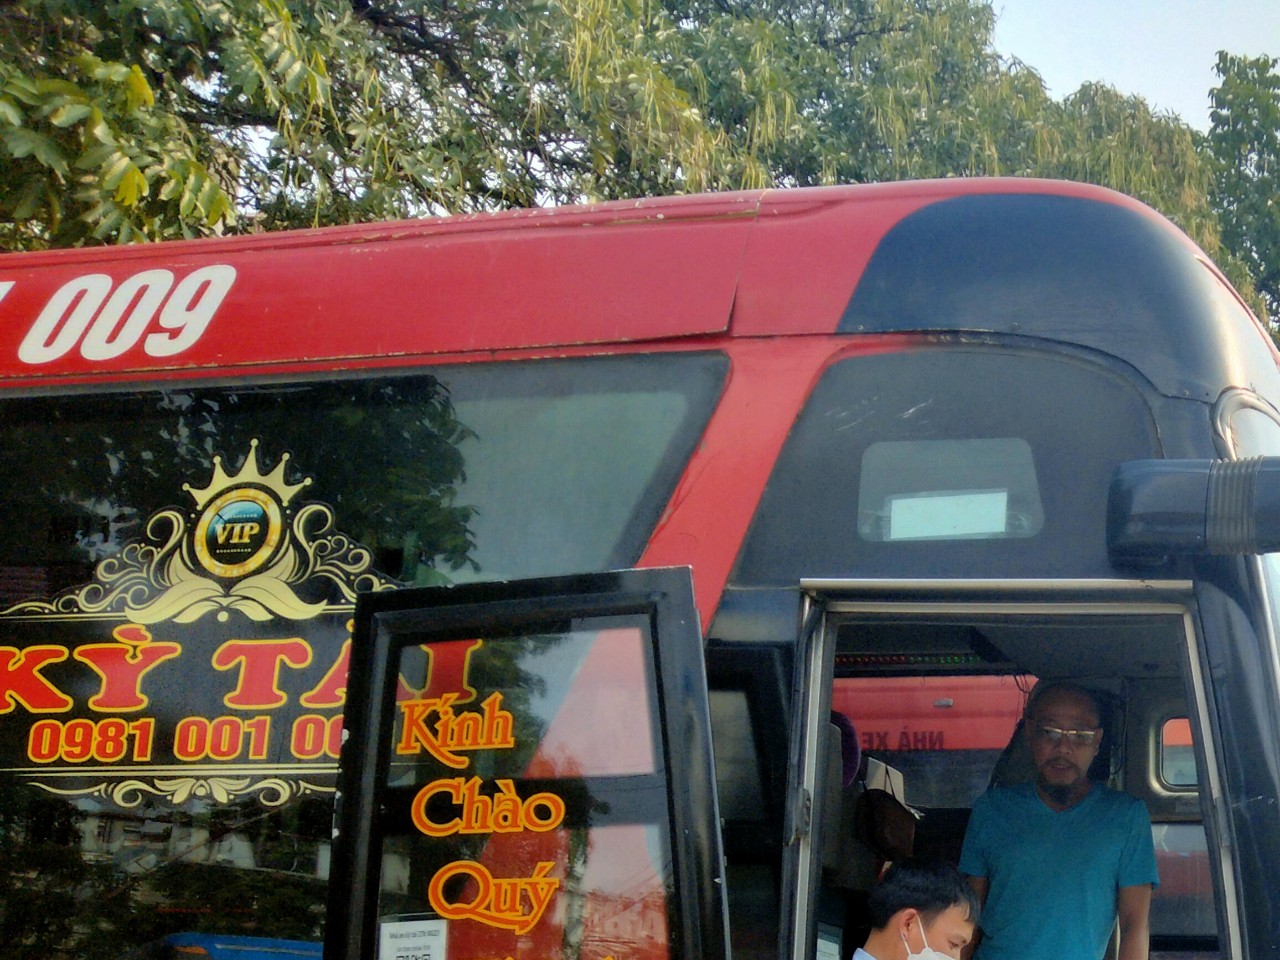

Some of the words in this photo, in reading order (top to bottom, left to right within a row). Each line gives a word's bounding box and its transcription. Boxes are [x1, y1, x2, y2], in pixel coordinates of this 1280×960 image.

[18, 265, 237, 364] 009
[214, 522, 260, 544] VIP
[27, 717, 155, 763] 0981
[173, 715, 271, 762] 001
[396, 691, 516, 769] Kính
[411, 775, 566, 837] Chào
[428, 860, 560, 935] Quý
